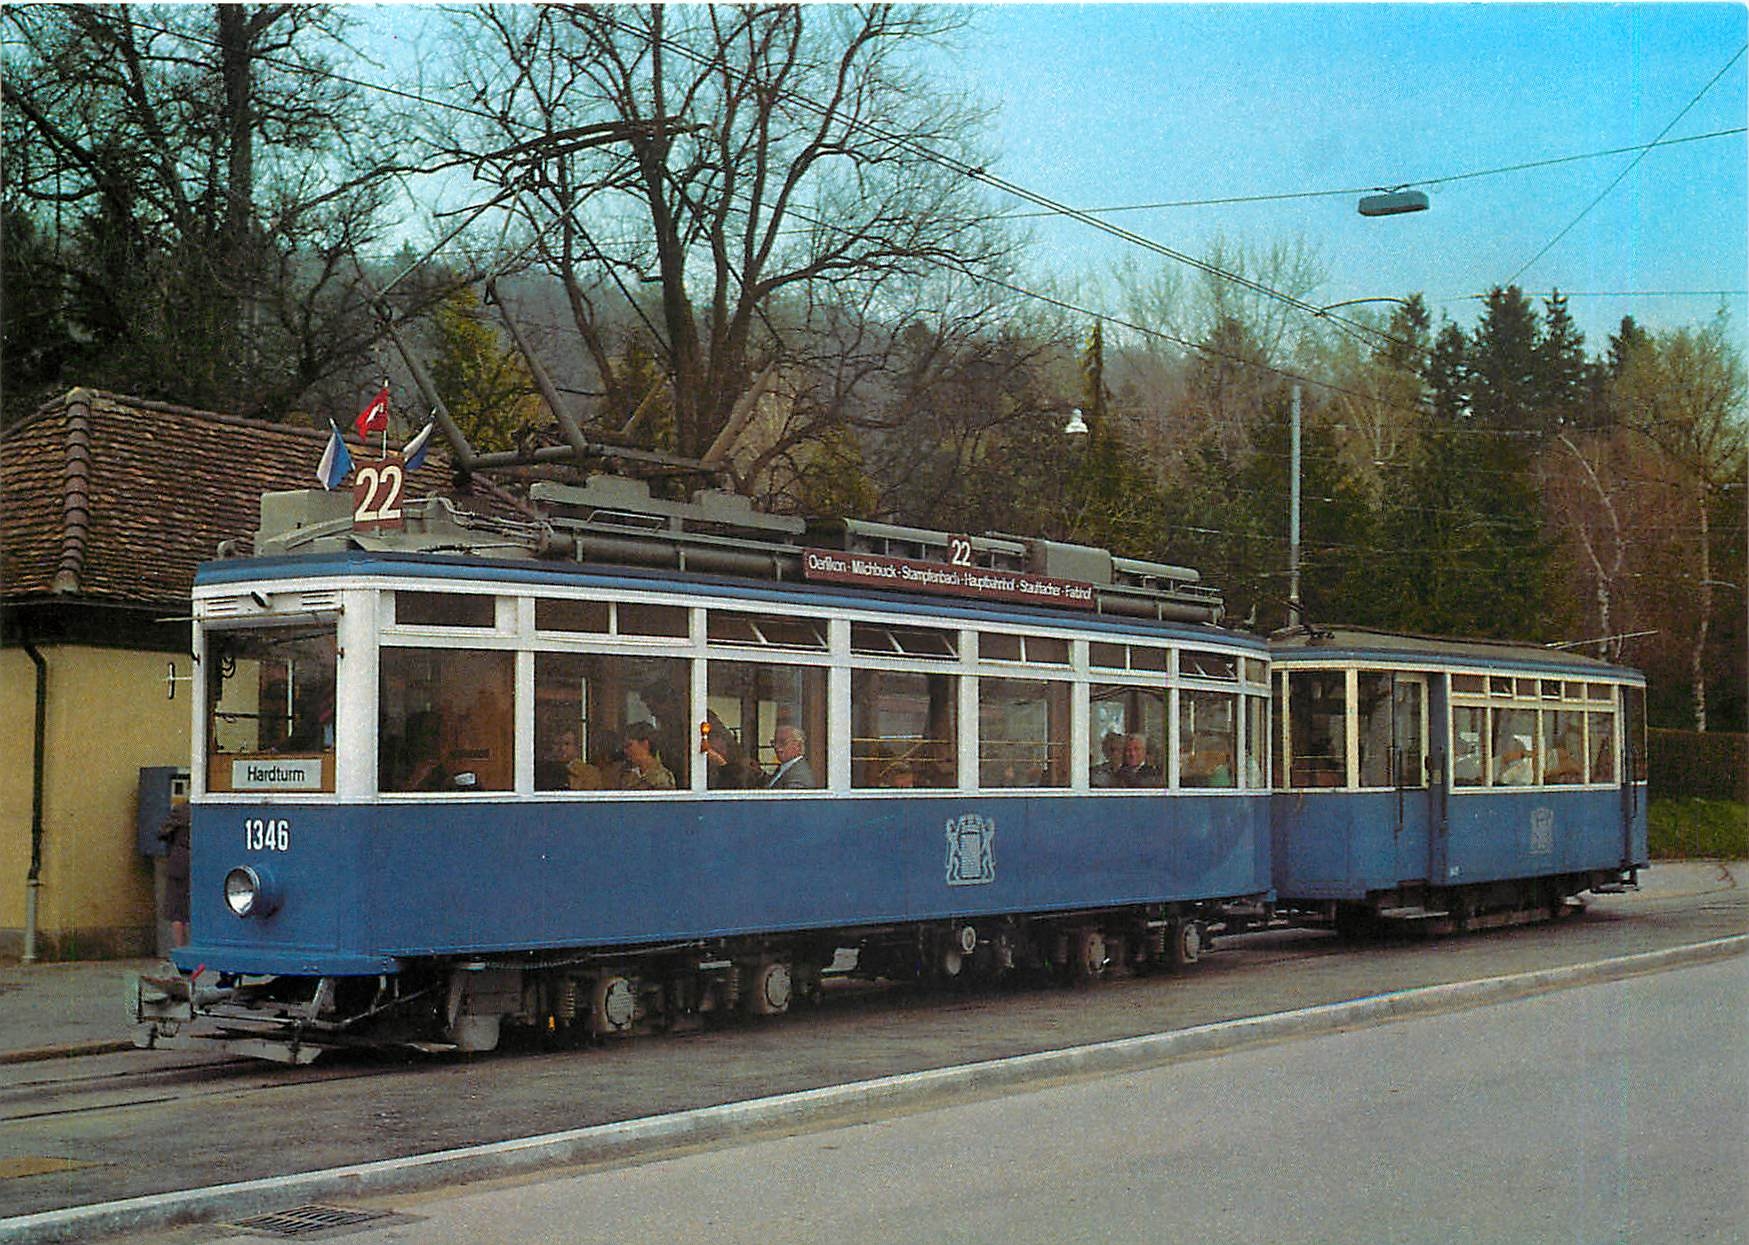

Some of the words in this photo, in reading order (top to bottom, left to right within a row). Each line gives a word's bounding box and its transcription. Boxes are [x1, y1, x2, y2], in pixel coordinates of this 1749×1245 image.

[355, 465, 402, 521] 22
[951, 539, 971, 567] 22
[808, 554, 847, 573] Oerlikon
[851, 559, 898, 579] Milchbuck
[901, 564, 961, 585] Stampfenbach
[963, 571, 1016, 592] Hauptbahnhof
[1019, 579, 1061, 597] Stauffacher
[247, 765, 305, 782] Hardturm
[245, 819, 289, 851] 1346
